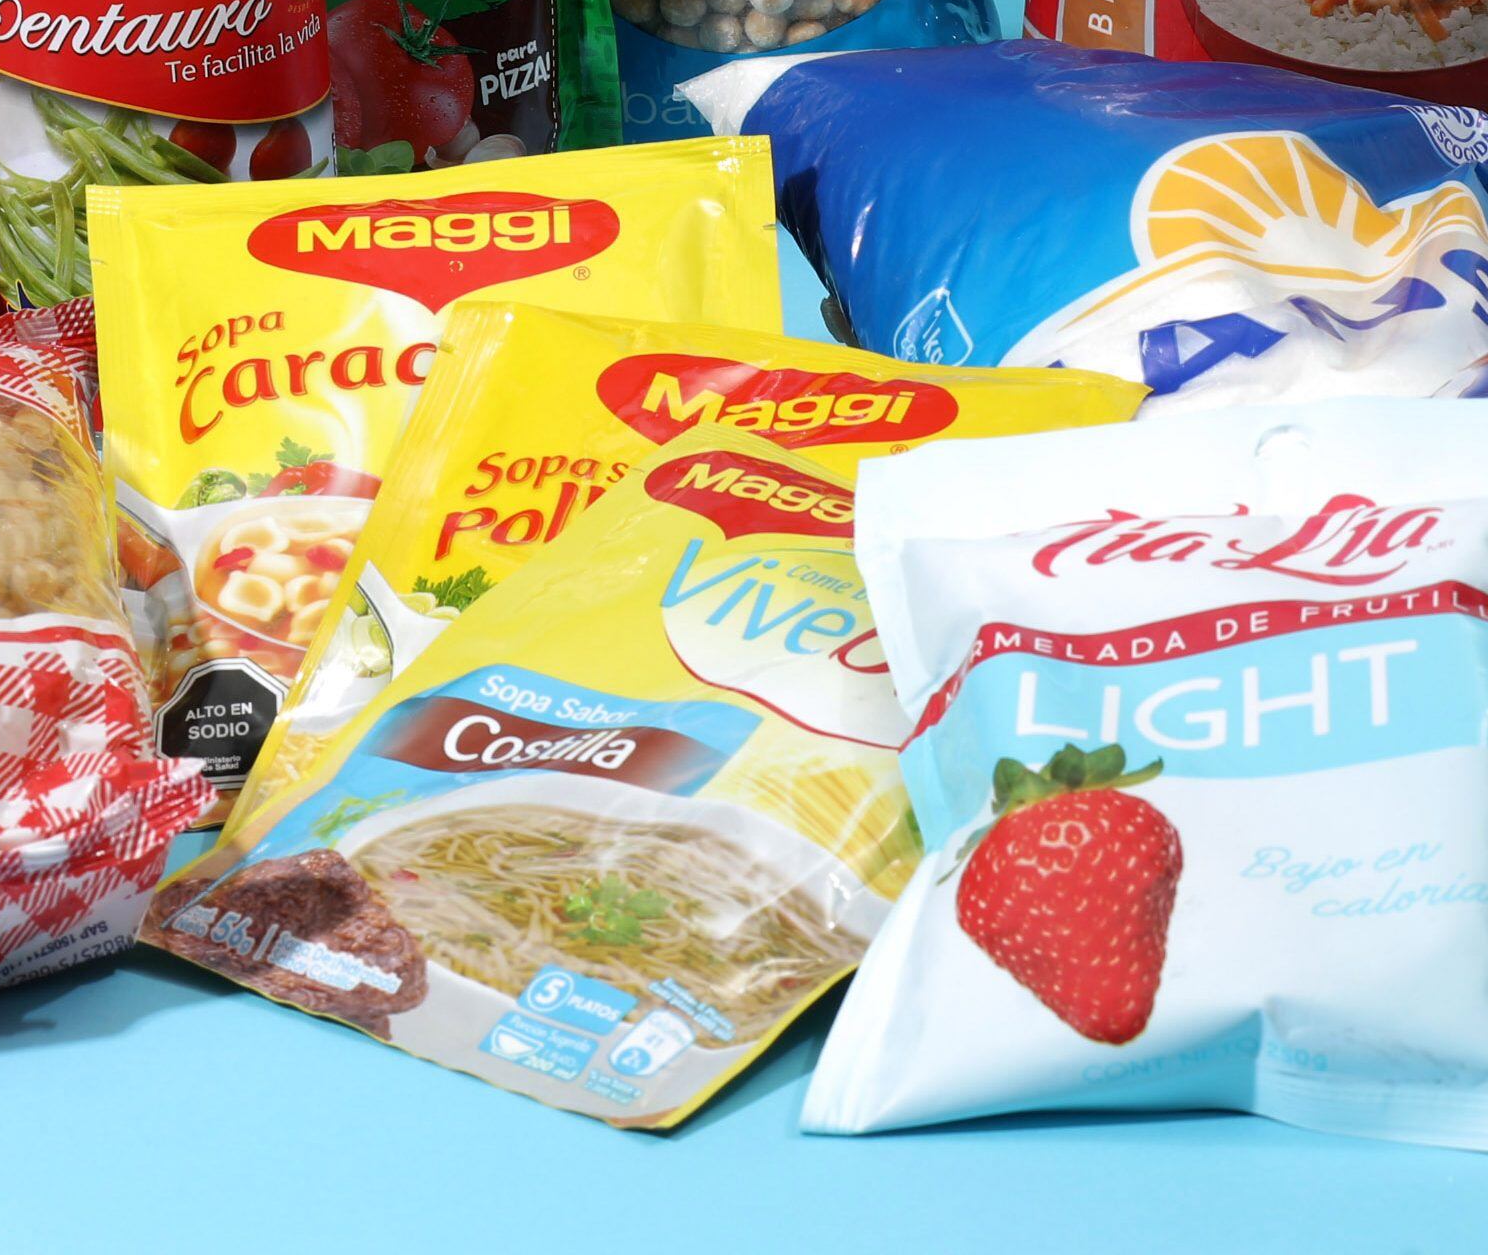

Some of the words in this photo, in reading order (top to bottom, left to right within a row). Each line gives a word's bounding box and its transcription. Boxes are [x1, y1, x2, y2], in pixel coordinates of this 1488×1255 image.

[165, 61, 197, 83] Te
[203, 41, 276, 78] facilita
[278, 32, 295, 56] la
[297, 13, 321, 45] vida
[496, 40, 537, 70] para
[480, 52, 551, 106] PIZZA!
[297, 207, 571, 253] Maggi
[177, 310, 284, 387] Sopa
[181, 341, 437, 444] Carac
[642, 371, 916, 431] Maggi
[676, 462, 854, 524] Magg
[787, 564, 853, 593] Come
[1215, 611, 1269, 643] DE
[185, 705, 226, 722] ALTO
[231, 702, 253, 716] EN
[478, 673, 553, 713] Sopa
[554, 694, 637, 726] Sabor
[1017, 640, 1416, 750] LIGHT
[188, 721, 250, 740] SODIO
[442, 713, 638, 771] Costilla
[215, 762, 239, 771] Salud
[1240, 846, 1362, 894] Bajo
[1373, 842, 1444, 872] en
[80, 920, 109, 940] SAP
[535, 978, 566, 1005] 5
[567, 994, 623, 1022] PLATOS
